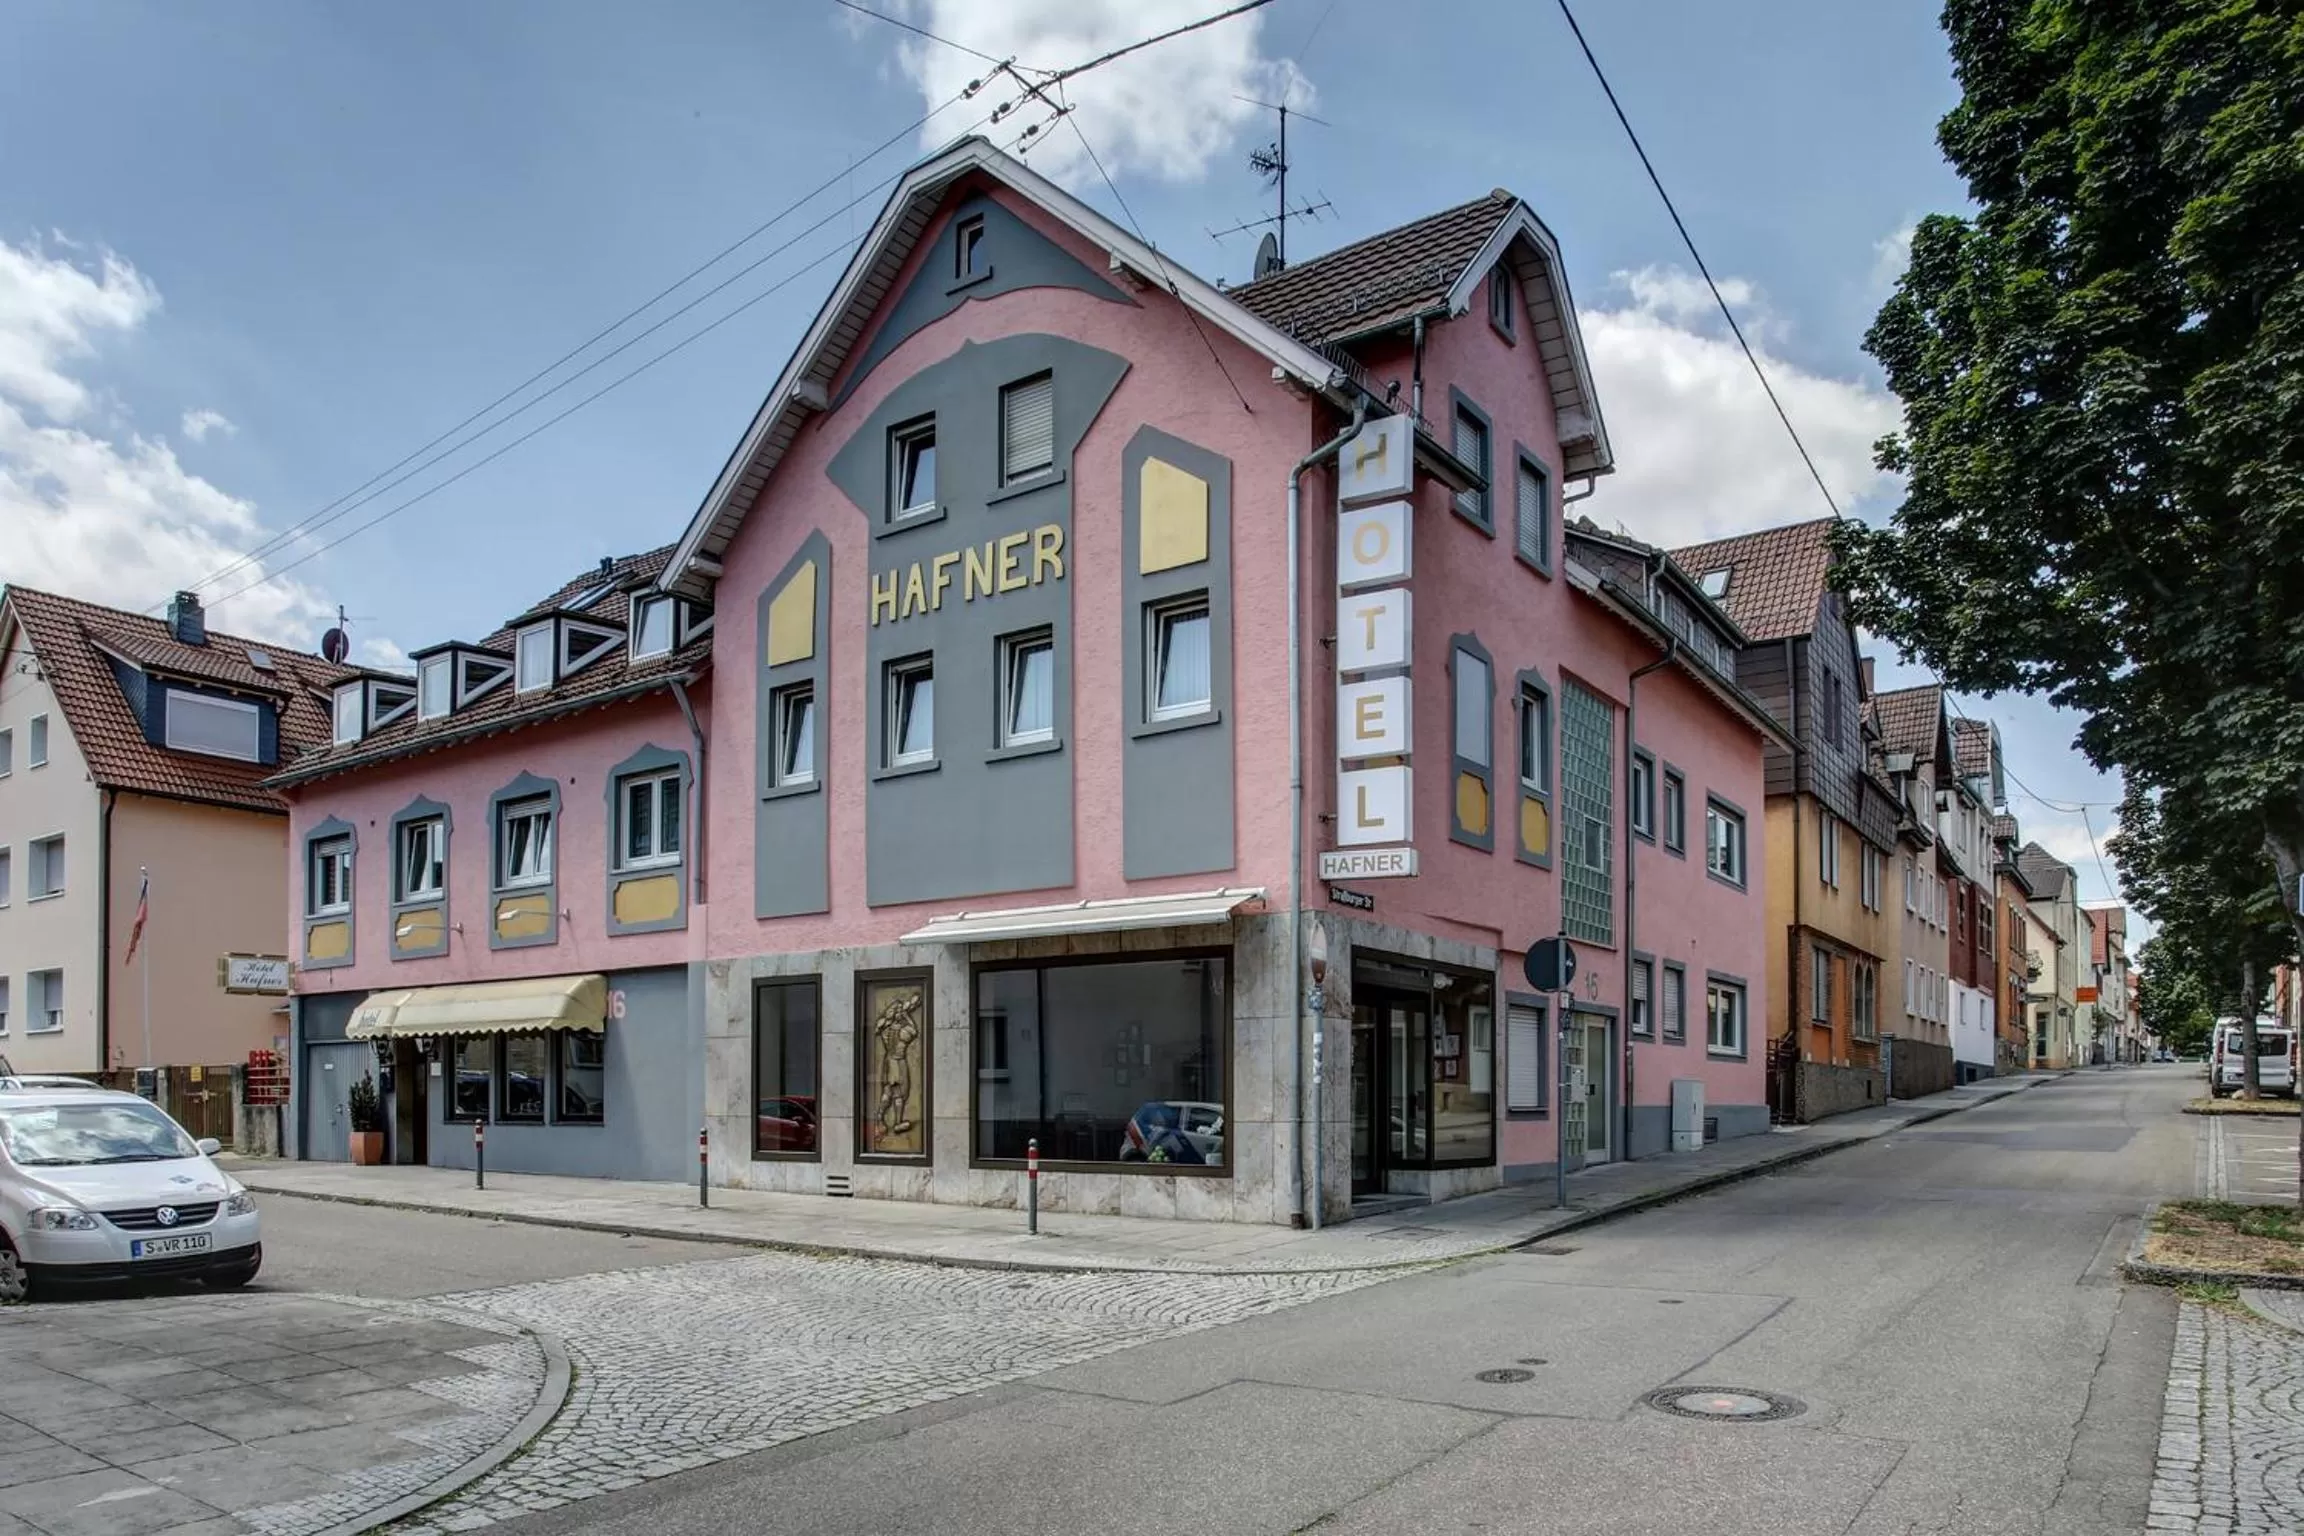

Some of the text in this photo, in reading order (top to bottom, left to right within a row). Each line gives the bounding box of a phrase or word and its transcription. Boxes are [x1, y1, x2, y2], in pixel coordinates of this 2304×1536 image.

[872, 523, 1065, 627] HAFNER
[1353, 434, 1391, 829] HOTEL
[1324, 854, 1403, 874] HAFNER
[244, 962, 276, 973] Hotel
[235, 973, 282, 989] Hafner
[146, 1236, 206, 1254] S VR 110
